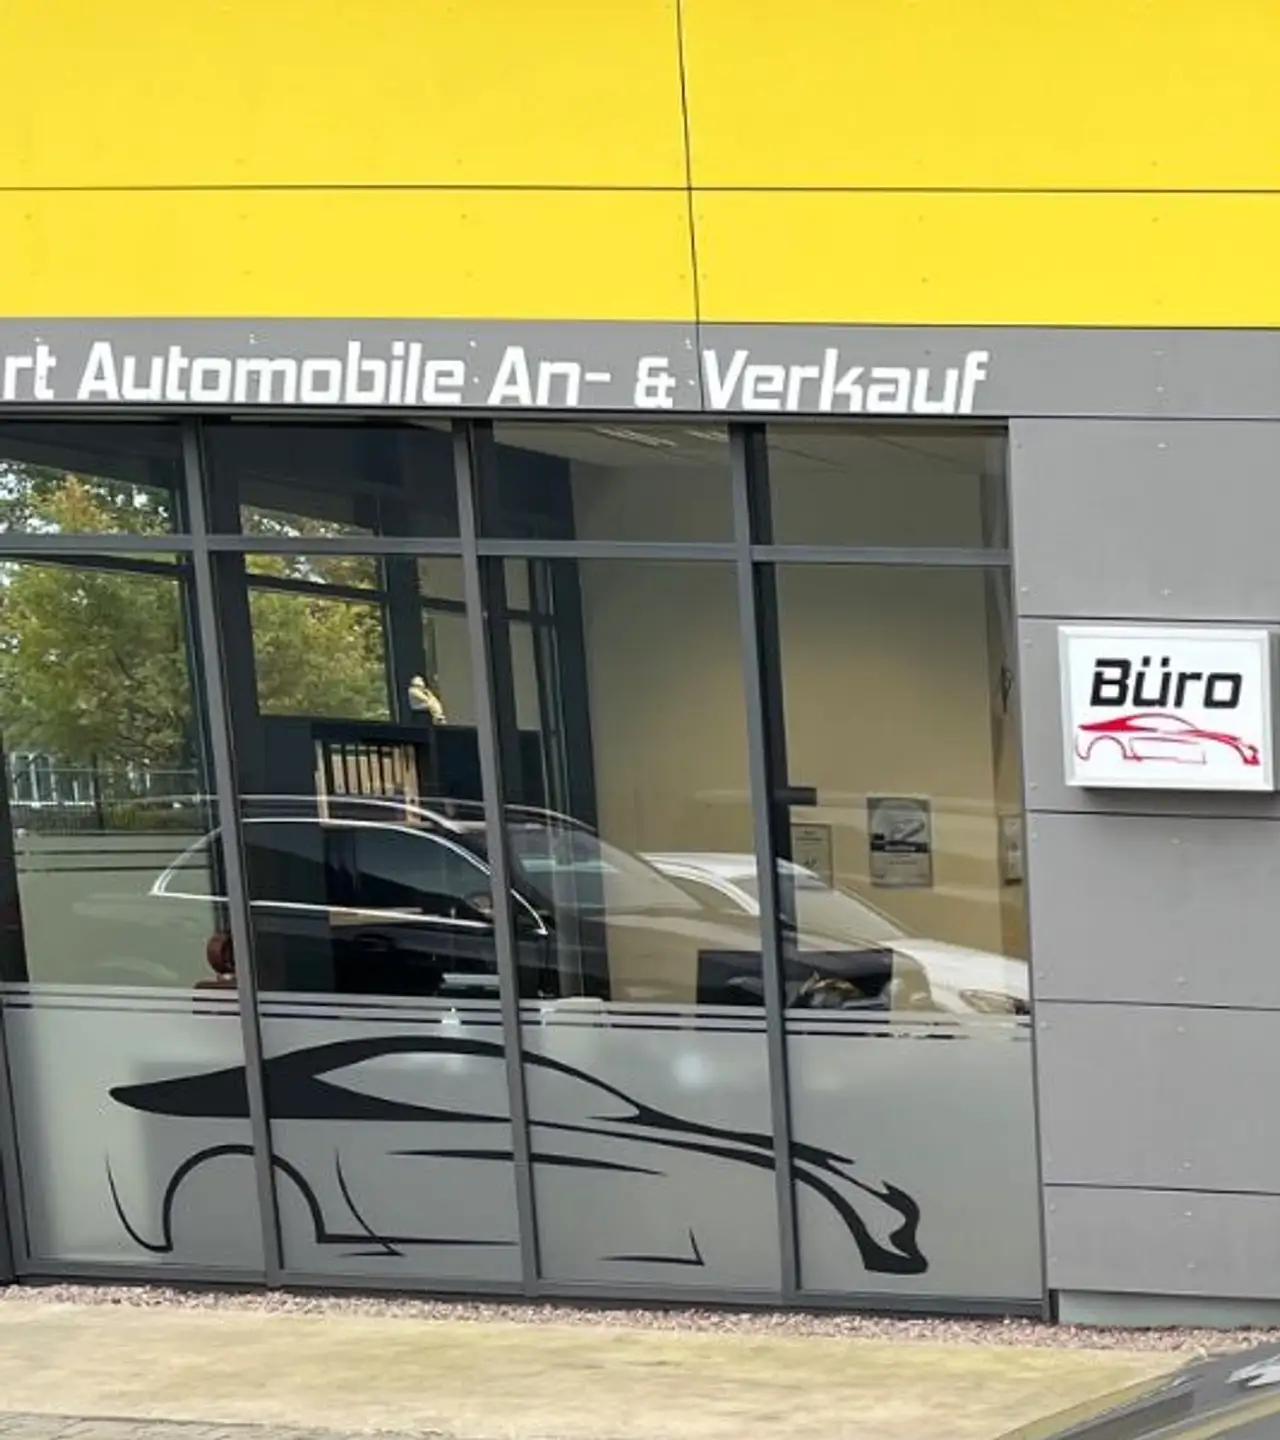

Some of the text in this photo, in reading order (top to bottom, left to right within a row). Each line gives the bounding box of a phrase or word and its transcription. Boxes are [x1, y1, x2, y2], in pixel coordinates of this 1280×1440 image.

[76, 341, 465, 406] Automobile
[487, 345, 611, 407] An-
[633, 356, 676, 409] &
[702, 349, 989, 414] Verkauf
[1090, 656, 1243, 709] Büro
